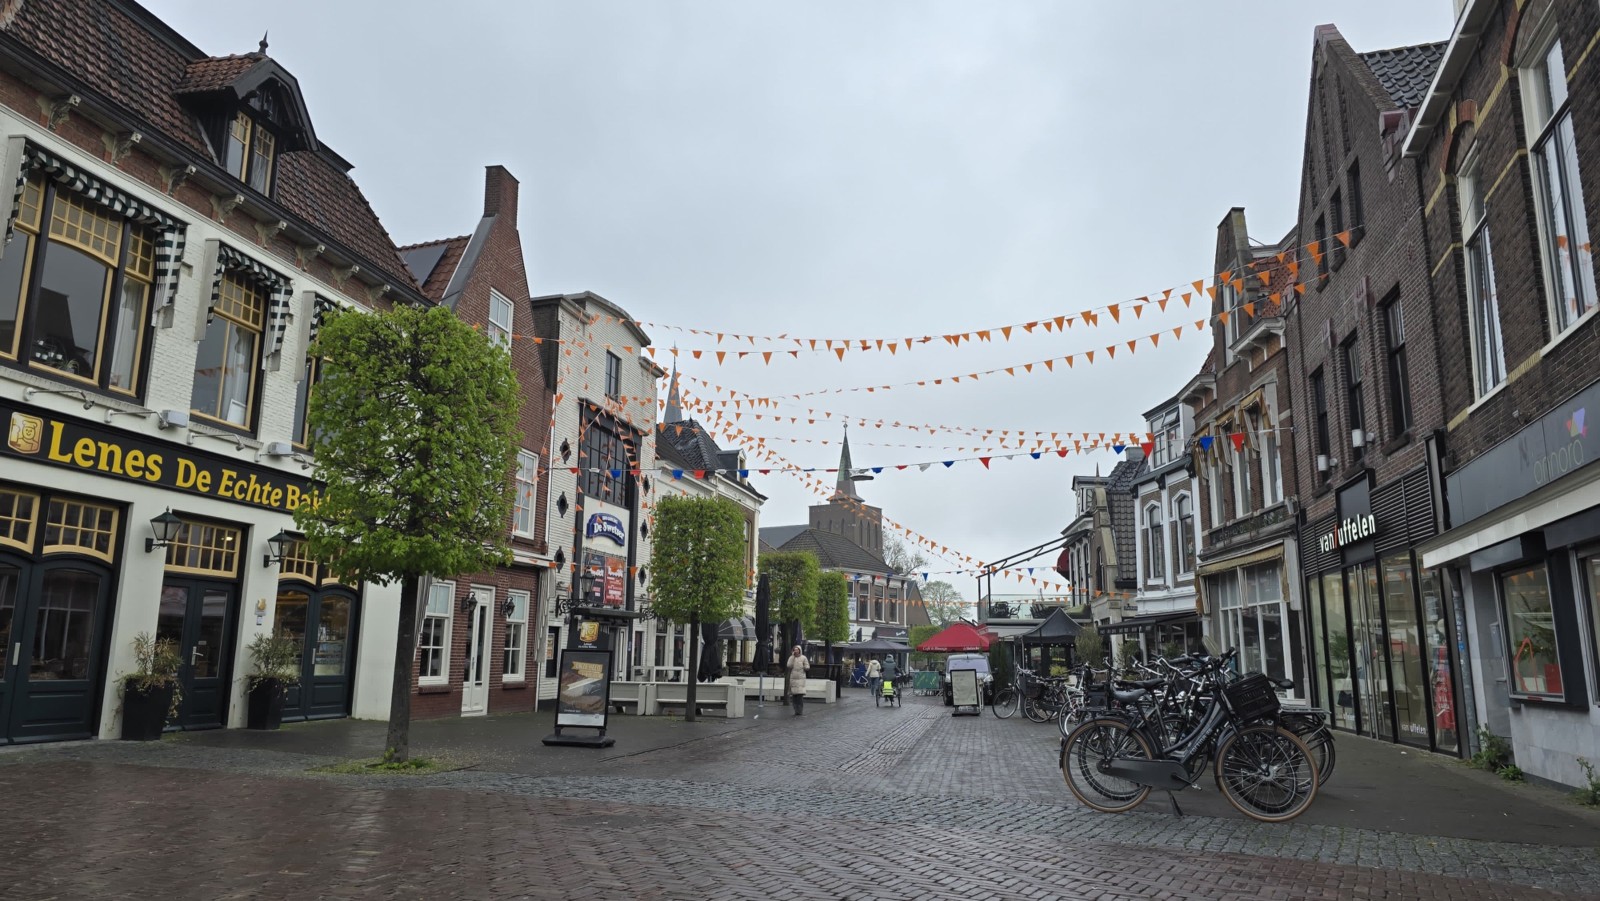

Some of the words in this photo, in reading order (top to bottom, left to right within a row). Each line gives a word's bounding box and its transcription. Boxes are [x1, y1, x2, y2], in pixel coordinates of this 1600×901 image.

[48, 420, 163, 482] Lenes
[175, 457, 212, 492] De
[217, 468, 283, 508] Echte
[1338, 514, 1376, 546] uffelen
